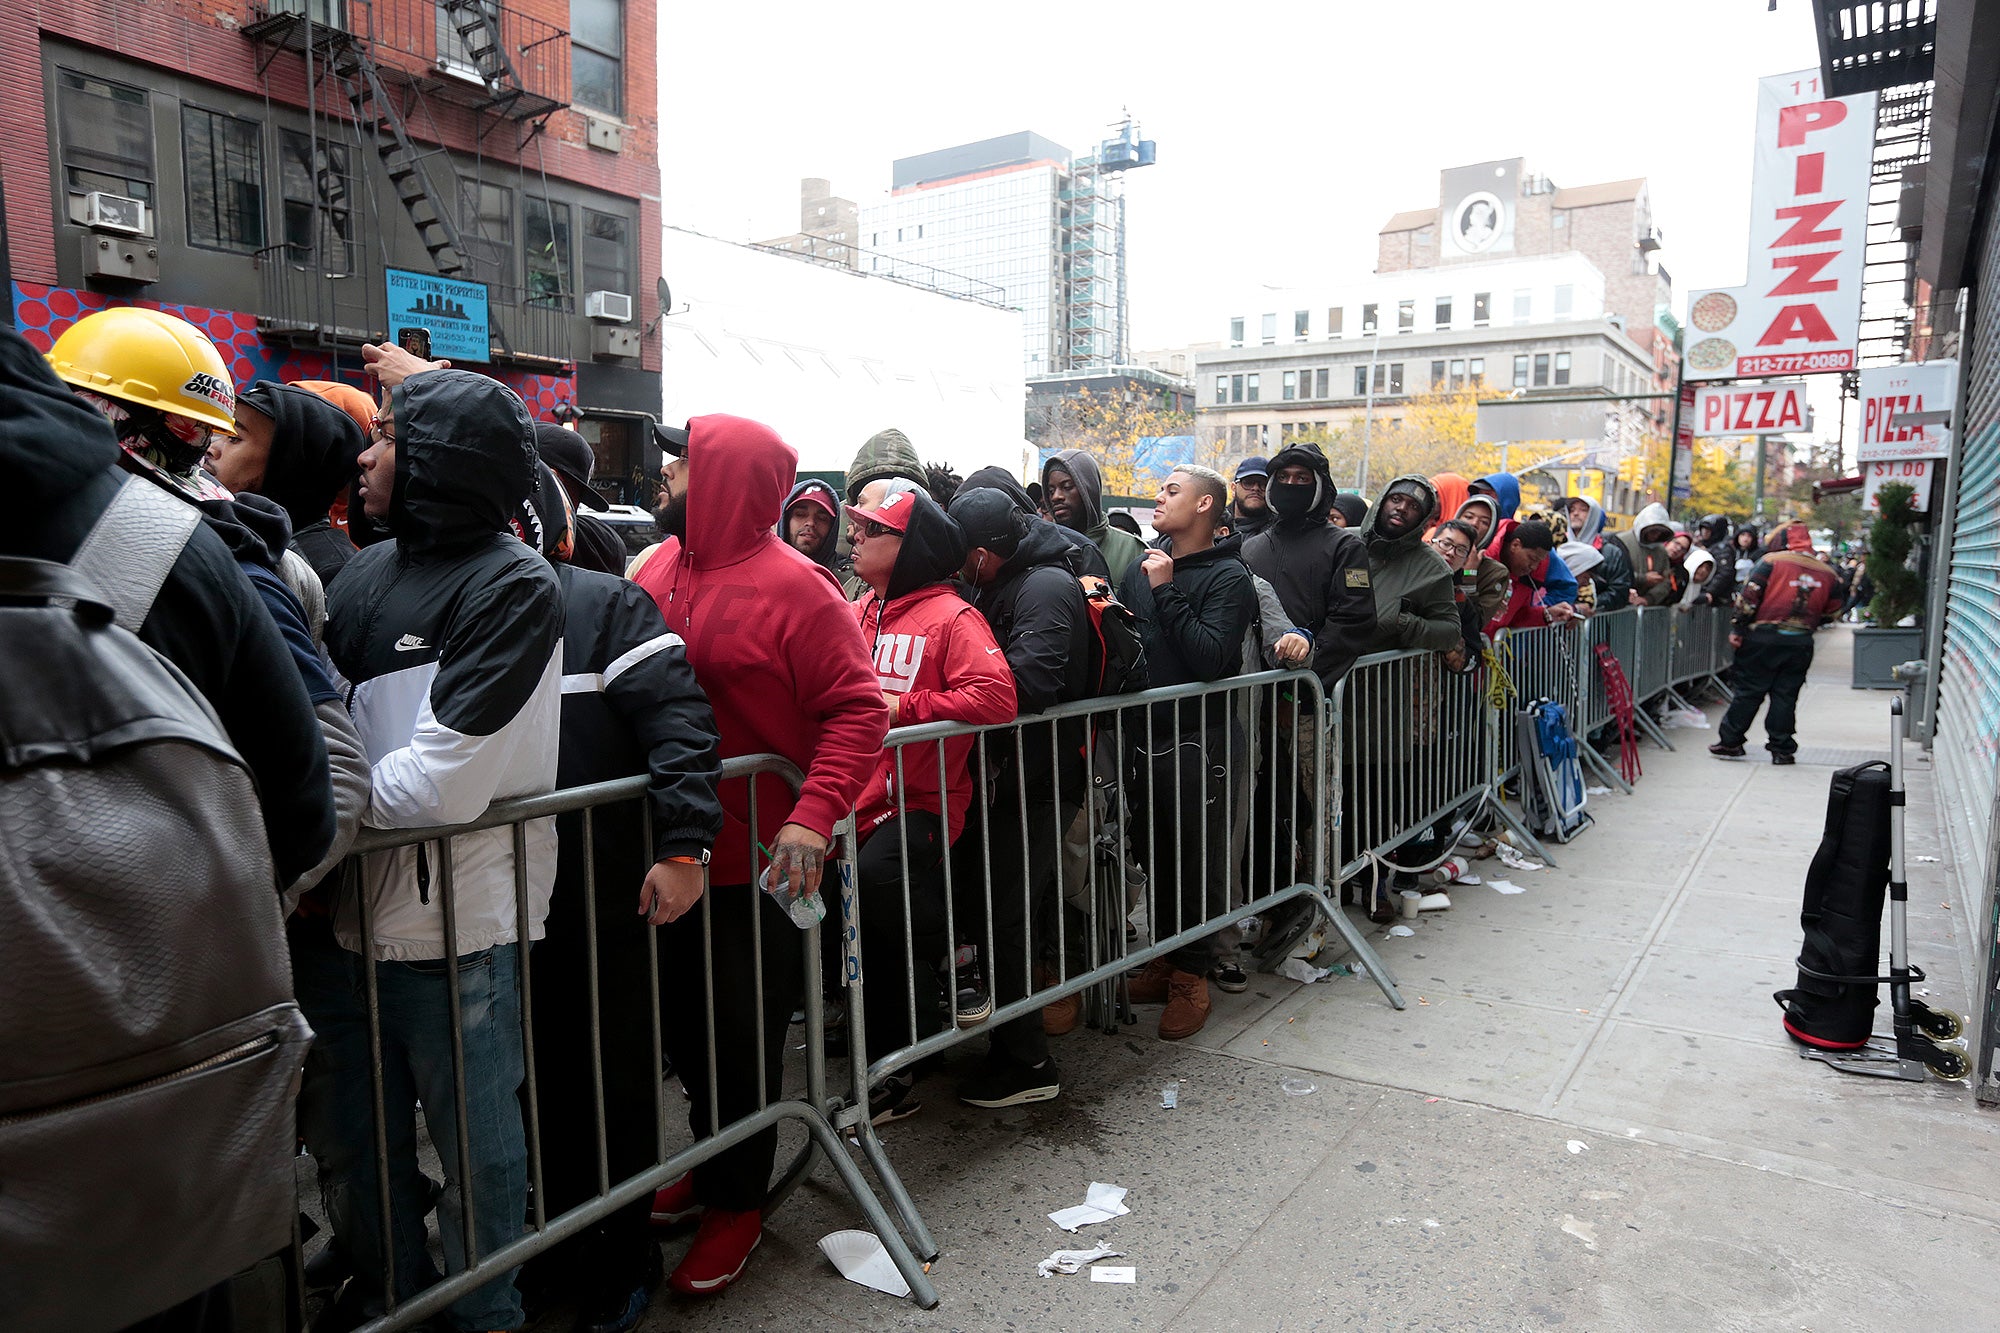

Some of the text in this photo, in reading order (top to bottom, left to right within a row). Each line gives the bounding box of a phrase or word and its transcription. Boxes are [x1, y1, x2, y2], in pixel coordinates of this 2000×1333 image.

[1755, 100, 1848, 347] PIZZA
[390, 274, 485, 300] BETTER LIVING PROPERTIES
[391, 313, 421, 325] EXCLUSIVE
[423, 318, 460, 331] APARTMENTS
[1741, 352, 1850, 373] 212-777-0080
[184, 382, 235, 411] ON FIRE
[1704, 389, 1801, 431] PIZZA
[1864, 394, 1924, 444] PIZZA
[400, 633, 425, 647] NIKE
